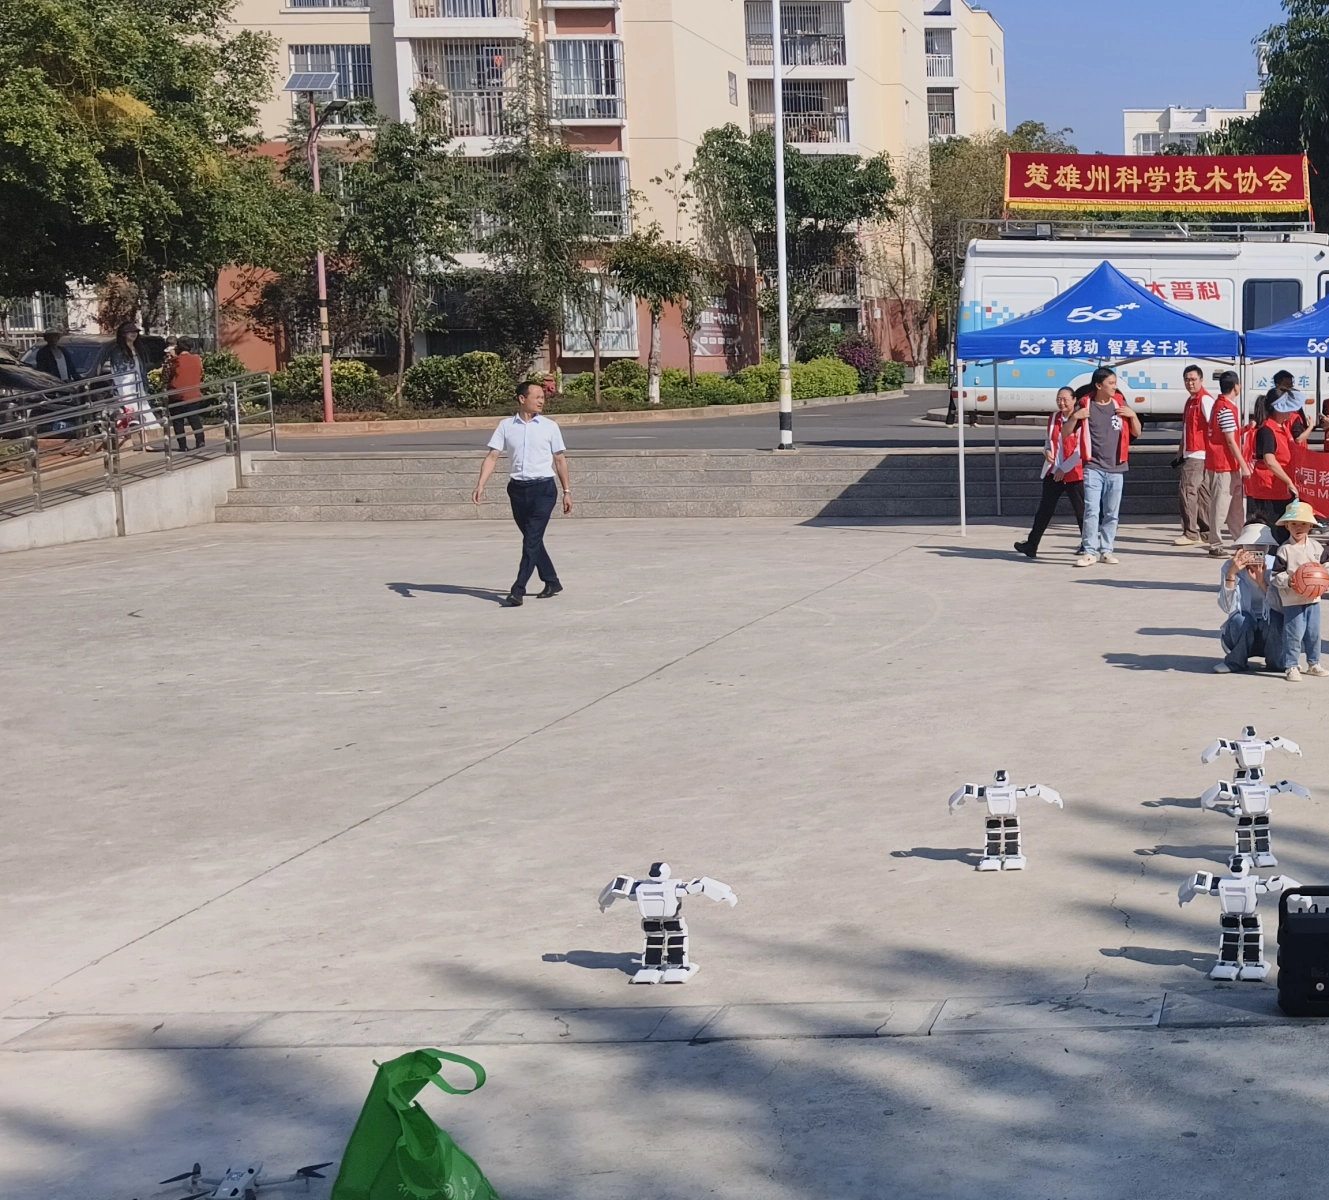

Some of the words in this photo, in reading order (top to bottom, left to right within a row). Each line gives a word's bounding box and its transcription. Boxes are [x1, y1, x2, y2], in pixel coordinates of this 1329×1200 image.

[1024, 162, 1292, 194] 楚雄州科学技术协会
[1050, 339, 1099, 355] 看移动
[1107, 339, 1189, 356] 智享全千兆
